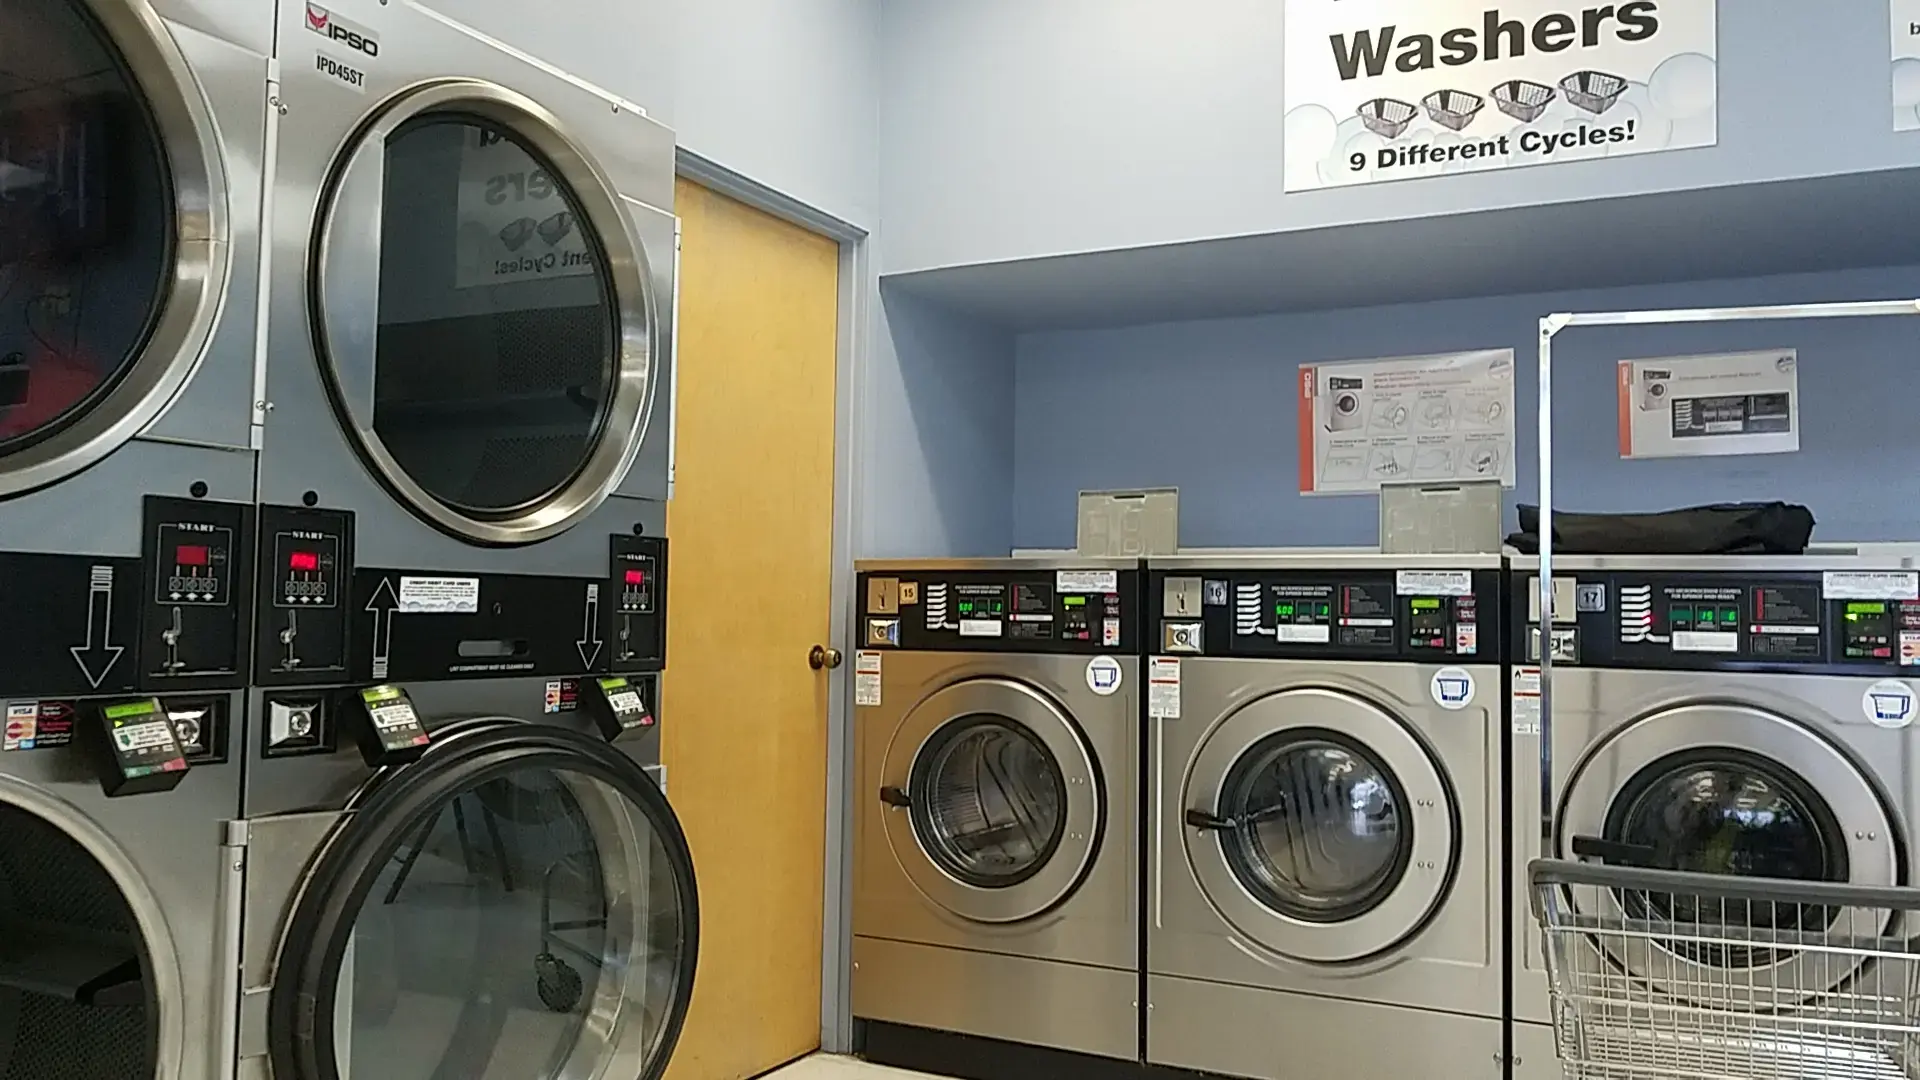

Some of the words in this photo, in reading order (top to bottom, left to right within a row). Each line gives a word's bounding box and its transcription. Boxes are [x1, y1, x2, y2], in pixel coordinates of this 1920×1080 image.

[328, 22, 378, 57] IPSO
[1329, 0, 1659, 81] Washers
[316, 55, 364, 87] IPD45ST
[1349, 151, 1367, 172] 9
[1377, 135, 1509, 170] Different
[1520, 119, 1636, 155] Cycles!
[178, 522, 215, 532] START
[292, 531, 323, 540] START
[903, 588, 913, 598] 15
[1210, 587, 1222, 599] 16
[1583, 592, 1598, 602] 17
